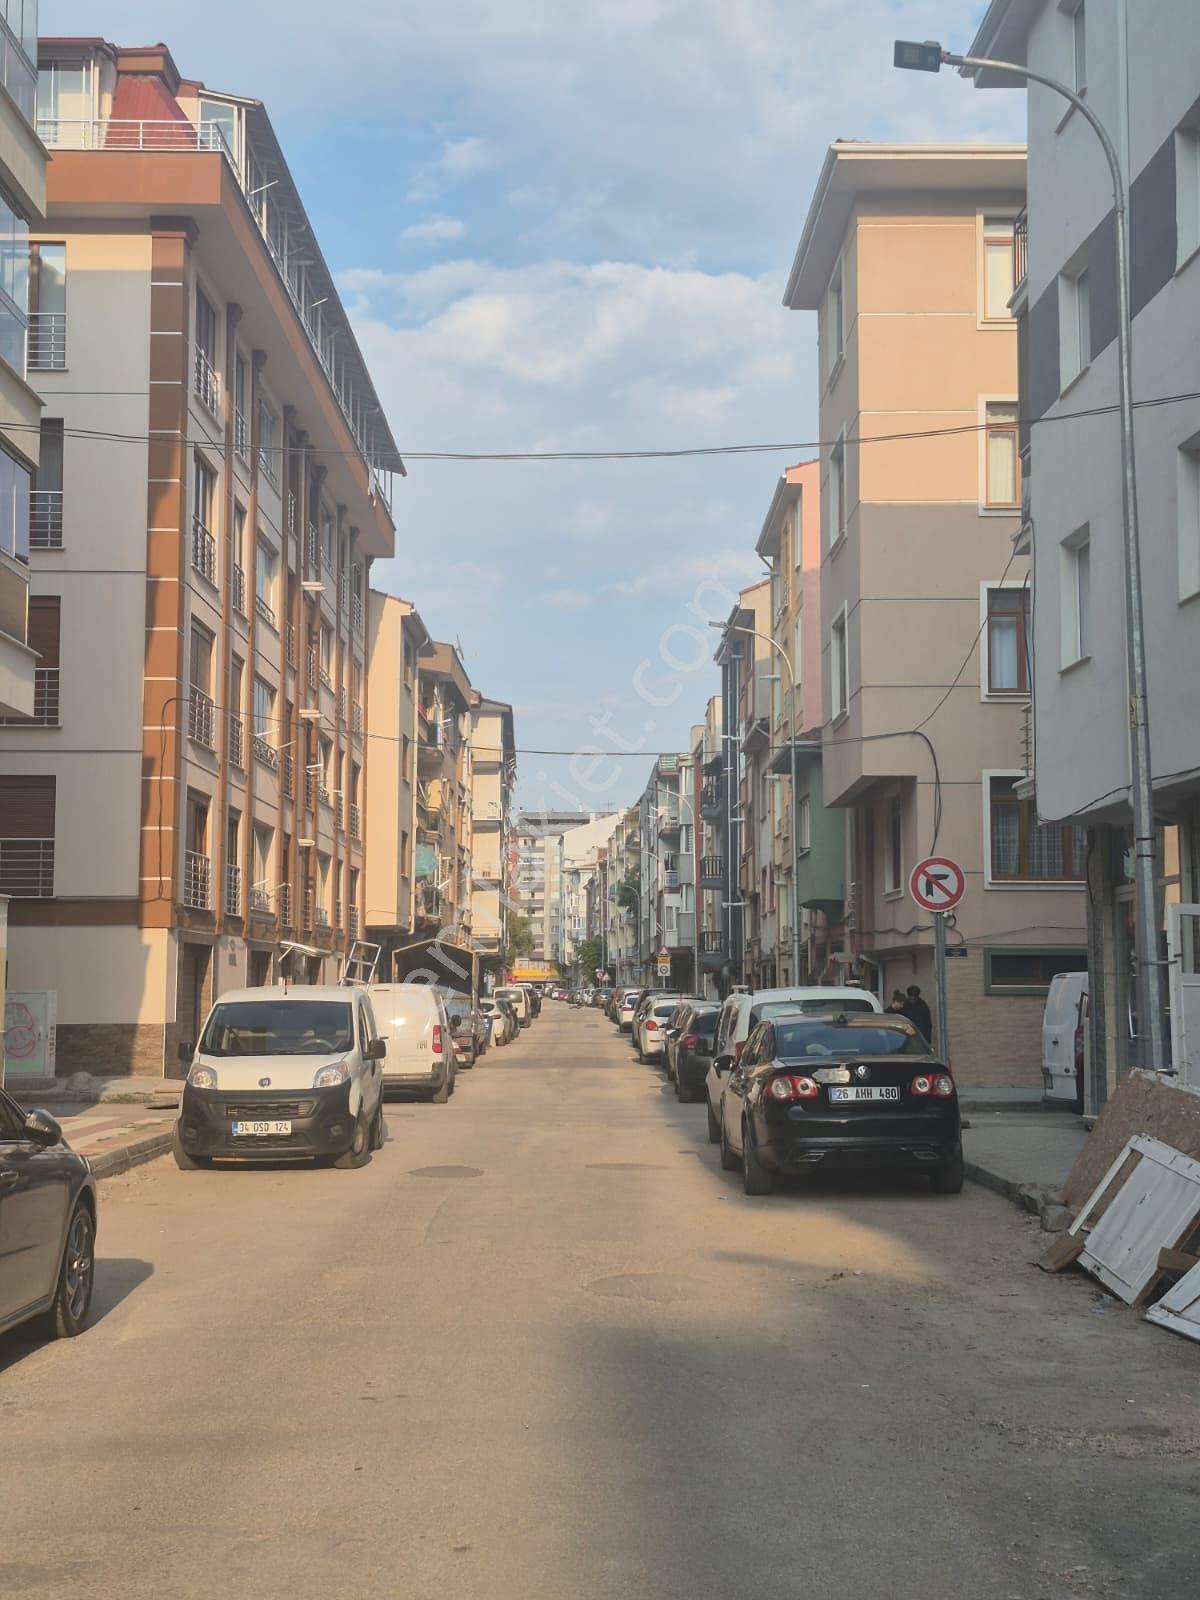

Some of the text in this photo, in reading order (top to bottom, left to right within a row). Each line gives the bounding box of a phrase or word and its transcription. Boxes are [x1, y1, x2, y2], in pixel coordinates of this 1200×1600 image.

[836, 1089, 849, 1099] 26
[240, 1123, 249, 1132] 34
[275, 1123, 288, 1132] 124
